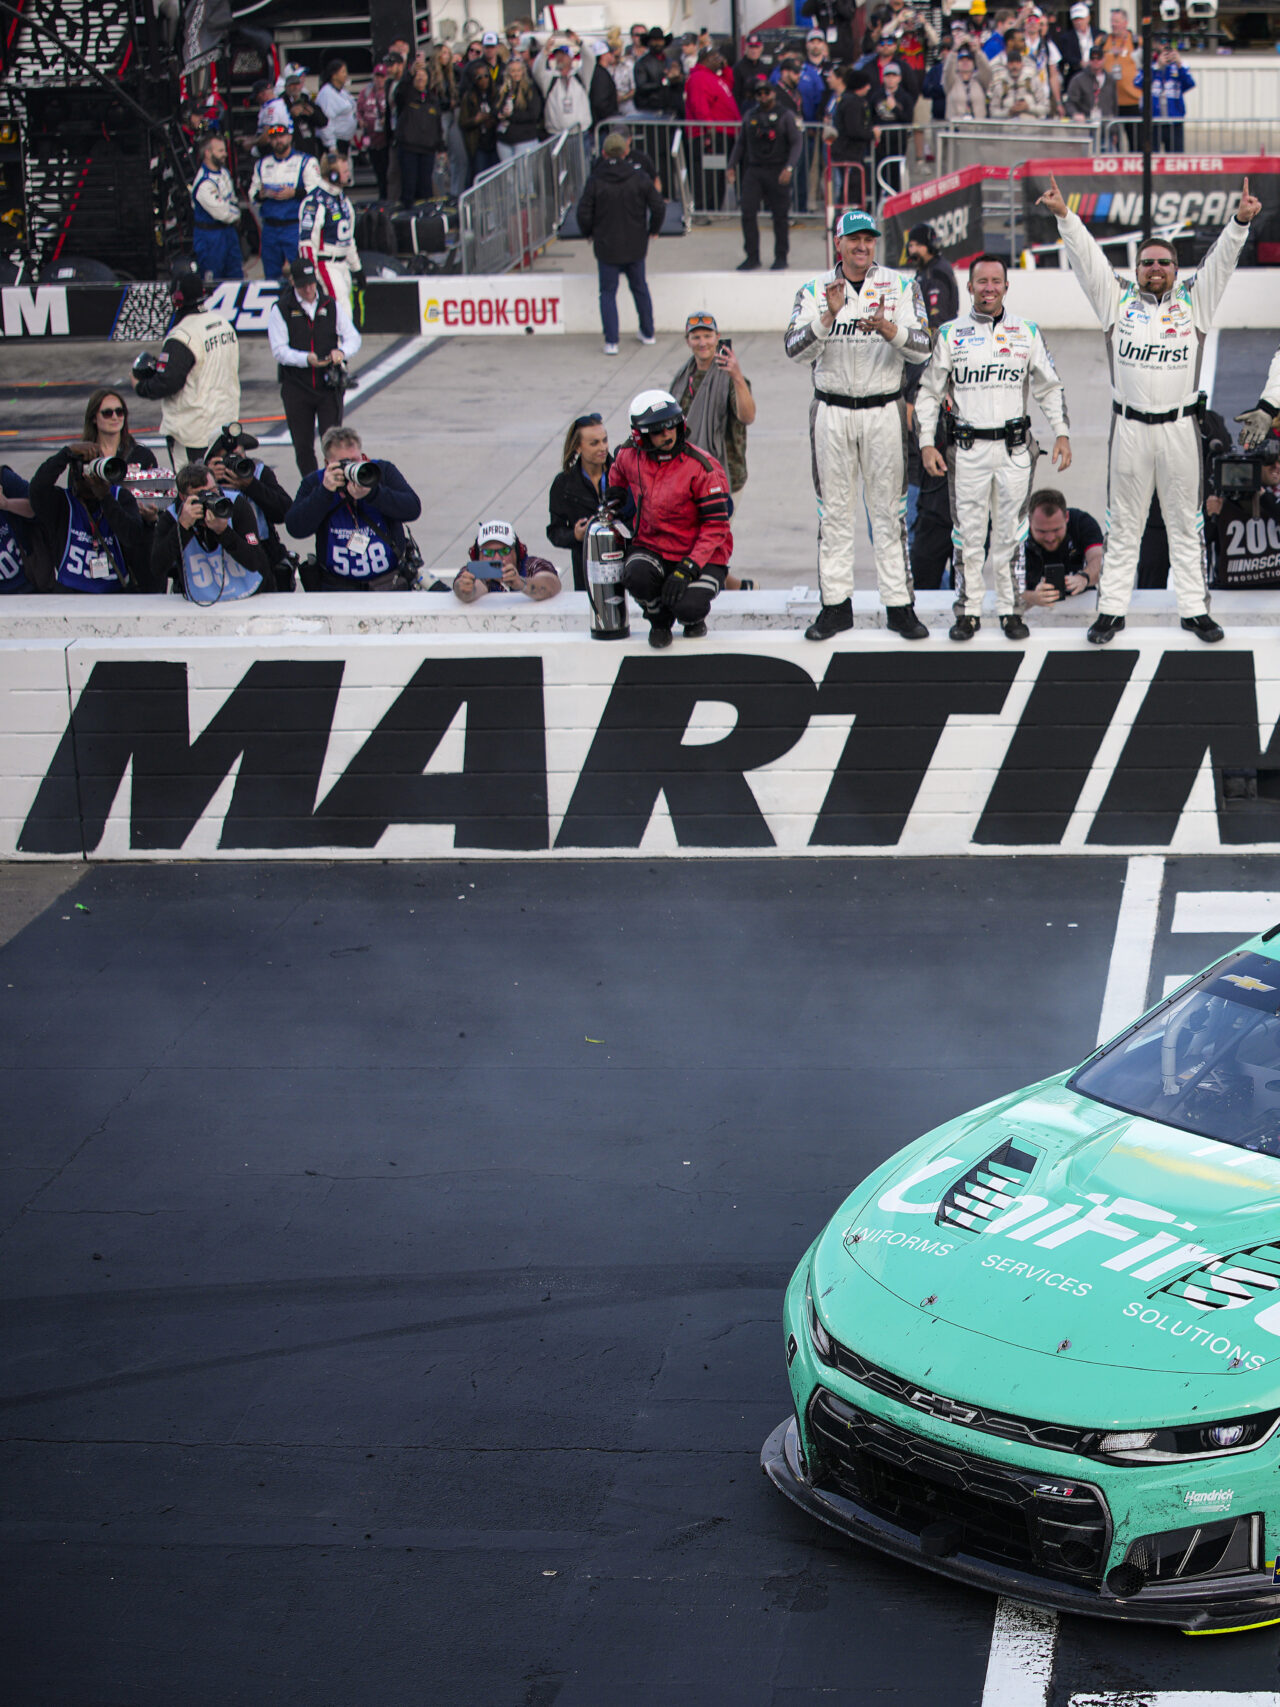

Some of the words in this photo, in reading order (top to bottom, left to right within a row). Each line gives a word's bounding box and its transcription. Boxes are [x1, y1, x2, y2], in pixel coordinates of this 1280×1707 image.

[1093, 158, 1118, 173] DO
[1123, 158, 1160, 172] NOT
[1164, 157, 1223, 171] ENTER
[0, 286, 70, 337] M
[203, 280, 281, 331] 45
[443, 298, 510, 326] COOK
[514, 297, 560, 325] OUT
[1118, 338, 1189, 363] UniFirst
[481, 525, 510, 537] PAPERCLIP
[332, 541, 389, 577] 538
[841, 1225, 954, 1257] UNIFORMS
[980, 1253, 1094, 1298] SERVICES
[1122, 1300, 1267, 1372] SOLUTIONS
[1035, 1483, 1076, 1497] ZL1
[1184, 1488, 1235, 1506] Hendrick
